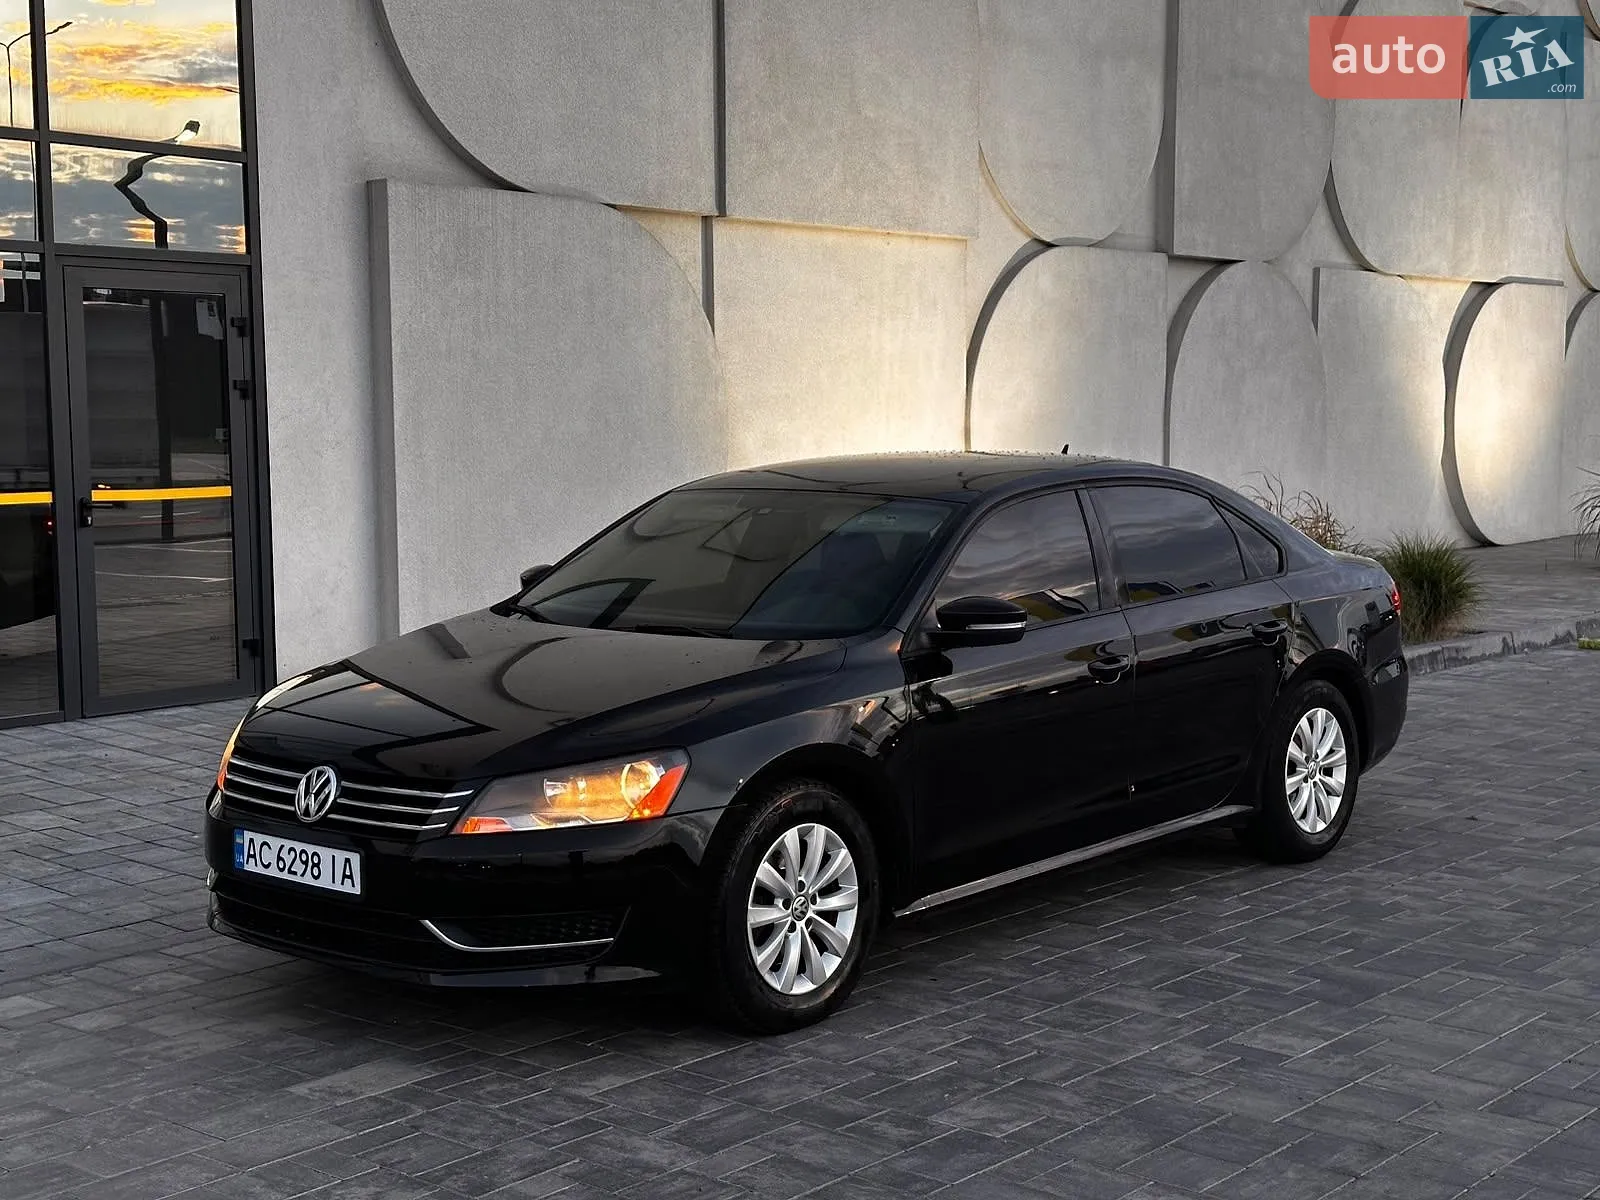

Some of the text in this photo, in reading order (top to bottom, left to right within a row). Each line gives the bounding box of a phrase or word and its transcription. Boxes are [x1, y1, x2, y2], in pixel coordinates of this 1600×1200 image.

[246, 837, 356, 888] AC 6298 IA
